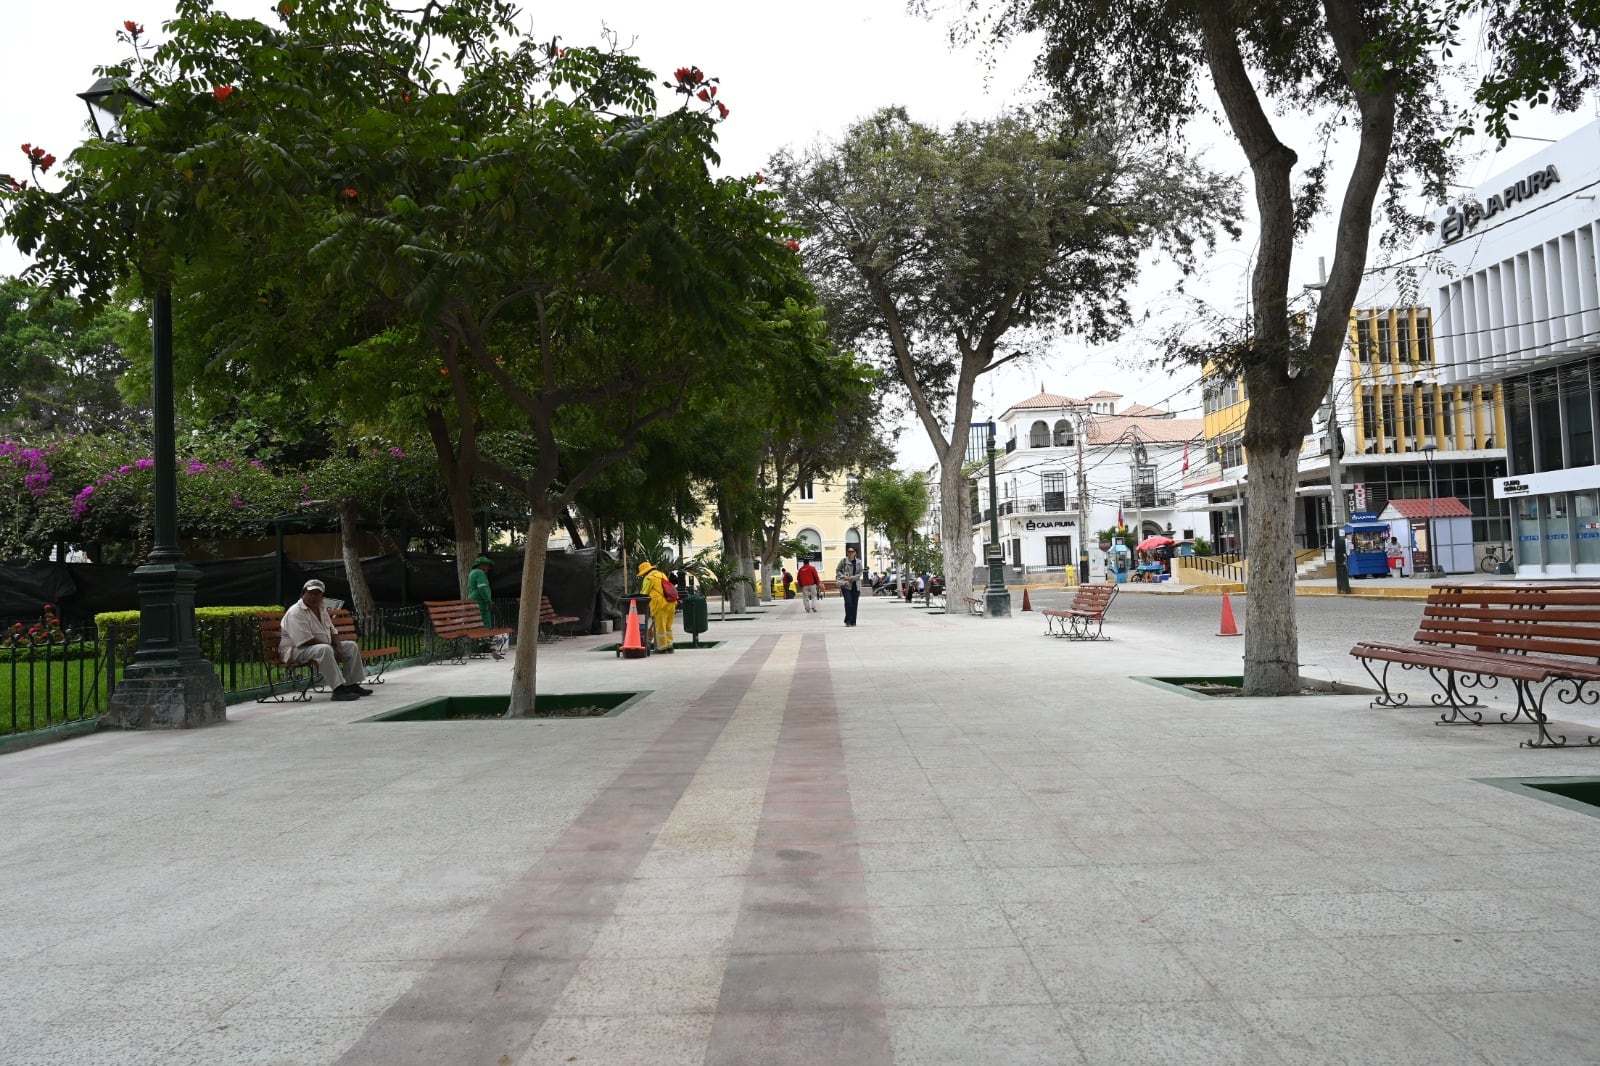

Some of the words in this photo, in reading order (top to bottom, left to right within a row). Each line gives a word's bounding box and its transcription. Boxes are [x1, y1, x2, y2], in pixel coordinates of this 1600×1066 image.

[1503, 163, 1560, 208] PIURA
[1036, 521, 1054, 529] CAJA
[1054, 520, 1076, 528] PIURA
